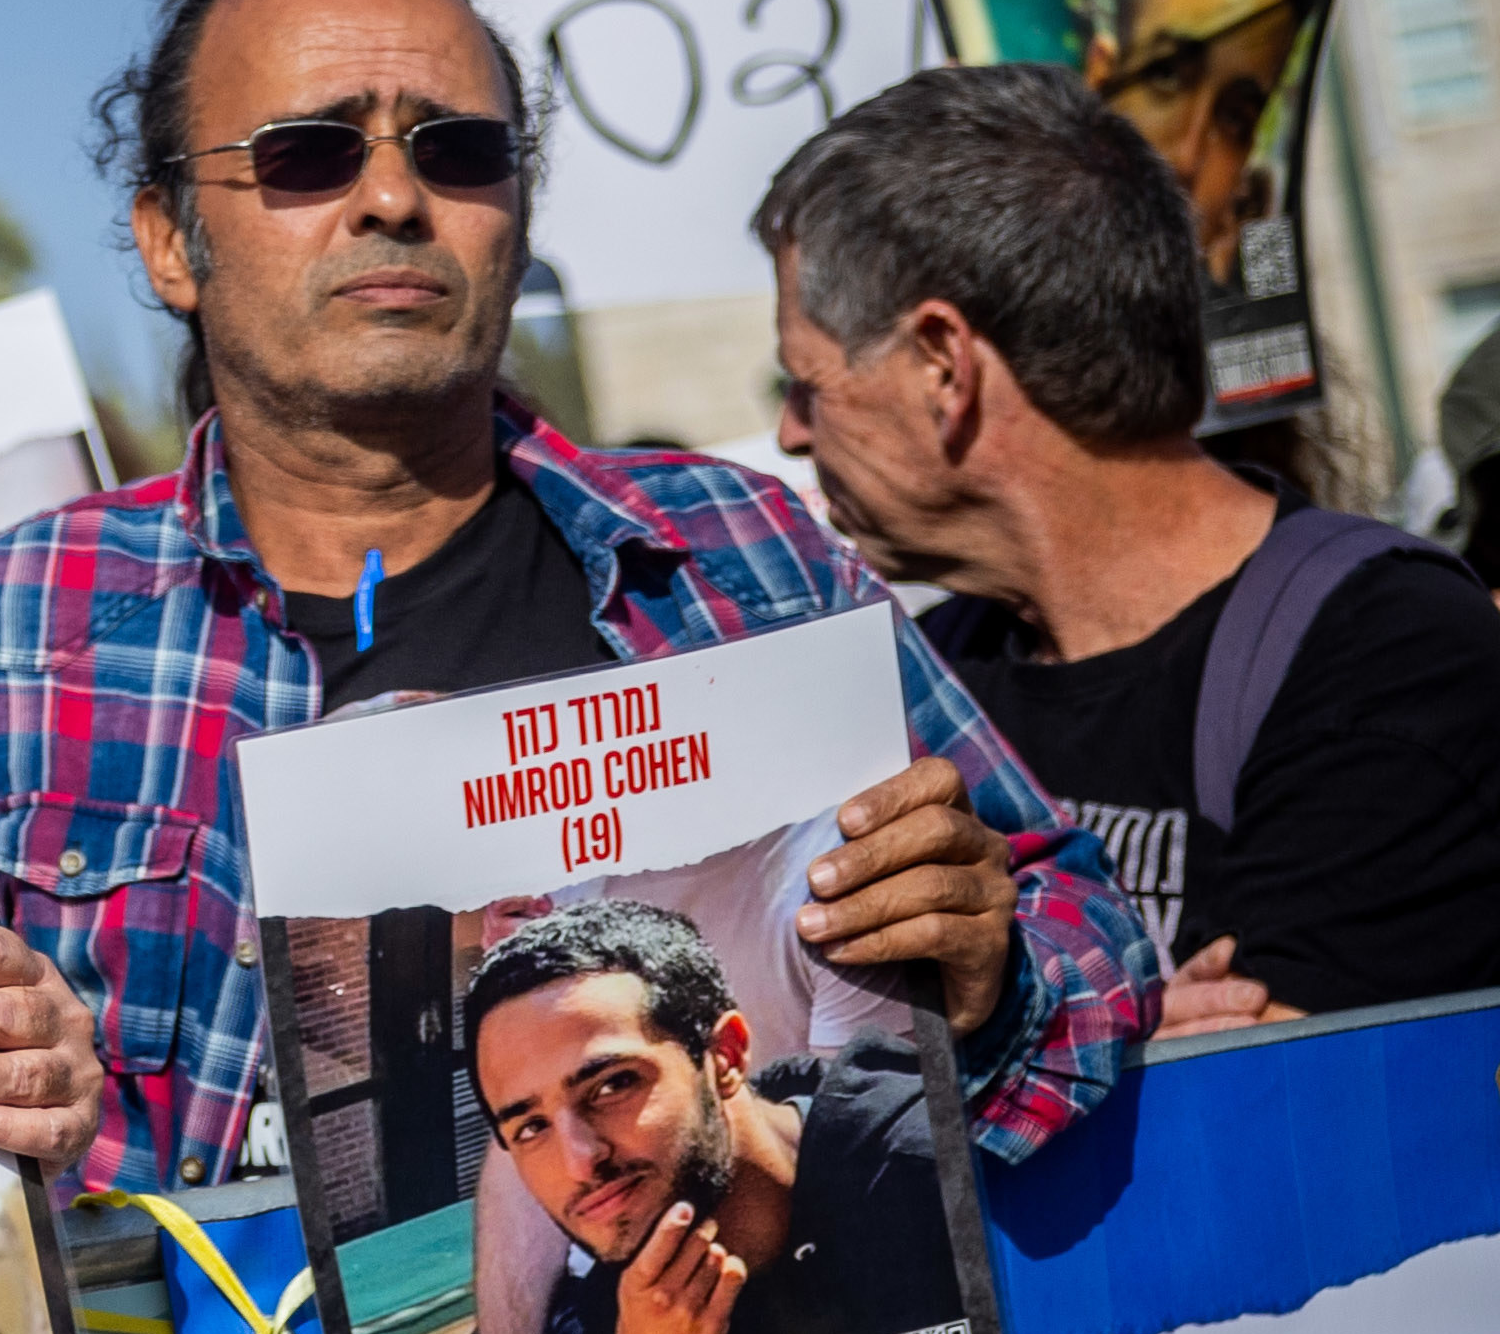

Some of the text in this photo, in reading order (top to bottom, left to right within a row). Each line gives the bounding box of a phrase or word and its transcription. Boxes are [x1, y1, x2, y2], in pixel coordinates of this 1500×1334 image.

[502, 683, 661, 765] נמרוד כהן
[463, 732, 711, 830] NIMROD COHEN
[562, 807, 622, 872] (19)
